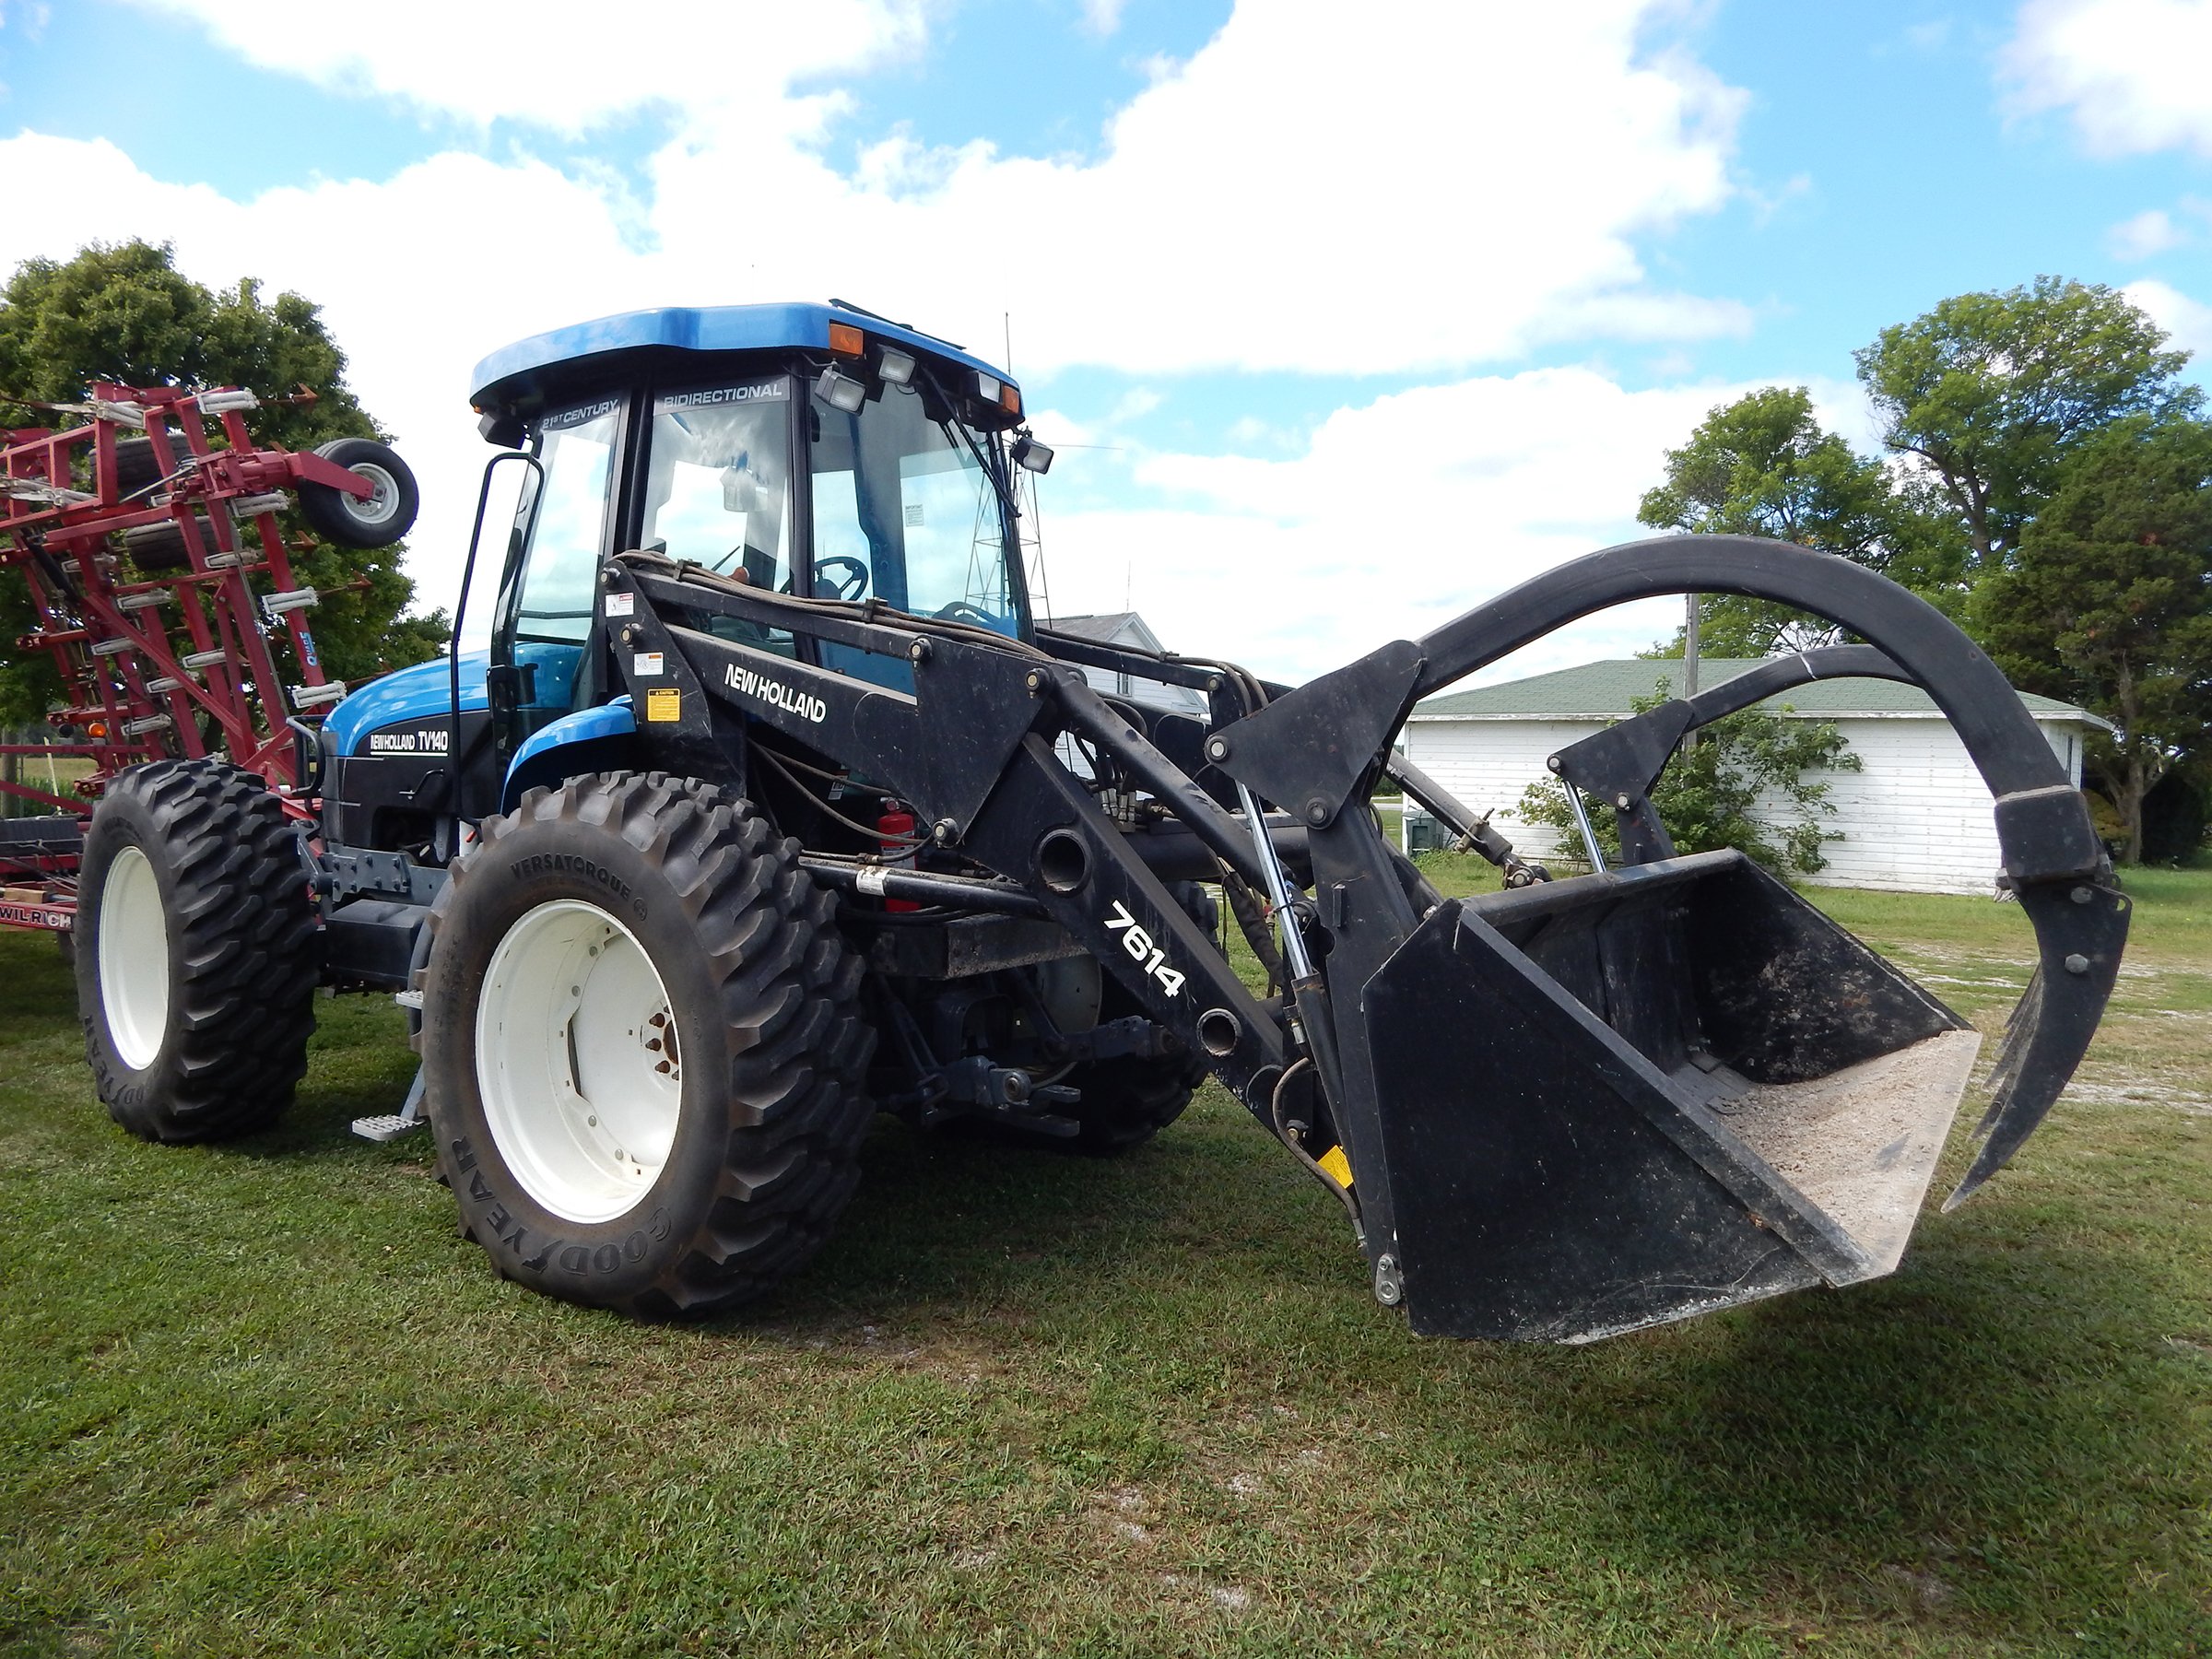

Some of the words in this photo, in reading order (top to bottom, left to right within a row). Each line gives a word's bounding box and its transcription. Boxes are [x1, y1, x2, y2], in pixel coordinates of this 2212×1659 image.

[542, 414, 564, 430] 21ST
[562, 398, 618, 424] CENTURY
[664, 383, 782, 408] BIDIRECTIONAL
[724, 663, 759, 696] NEW
[756, 676, 827, 724] HOLLAND
[371, 735, 385, 750] NEW
[383, 735, 416, 750] HOLLAND
[418, 731, 449, 751] TV140
[509, 853, 631, 900] VERSATORQUE
[1103, 900, 1186, 998] 7614
[452, 1135, 672, 1277] GOODYEAR
